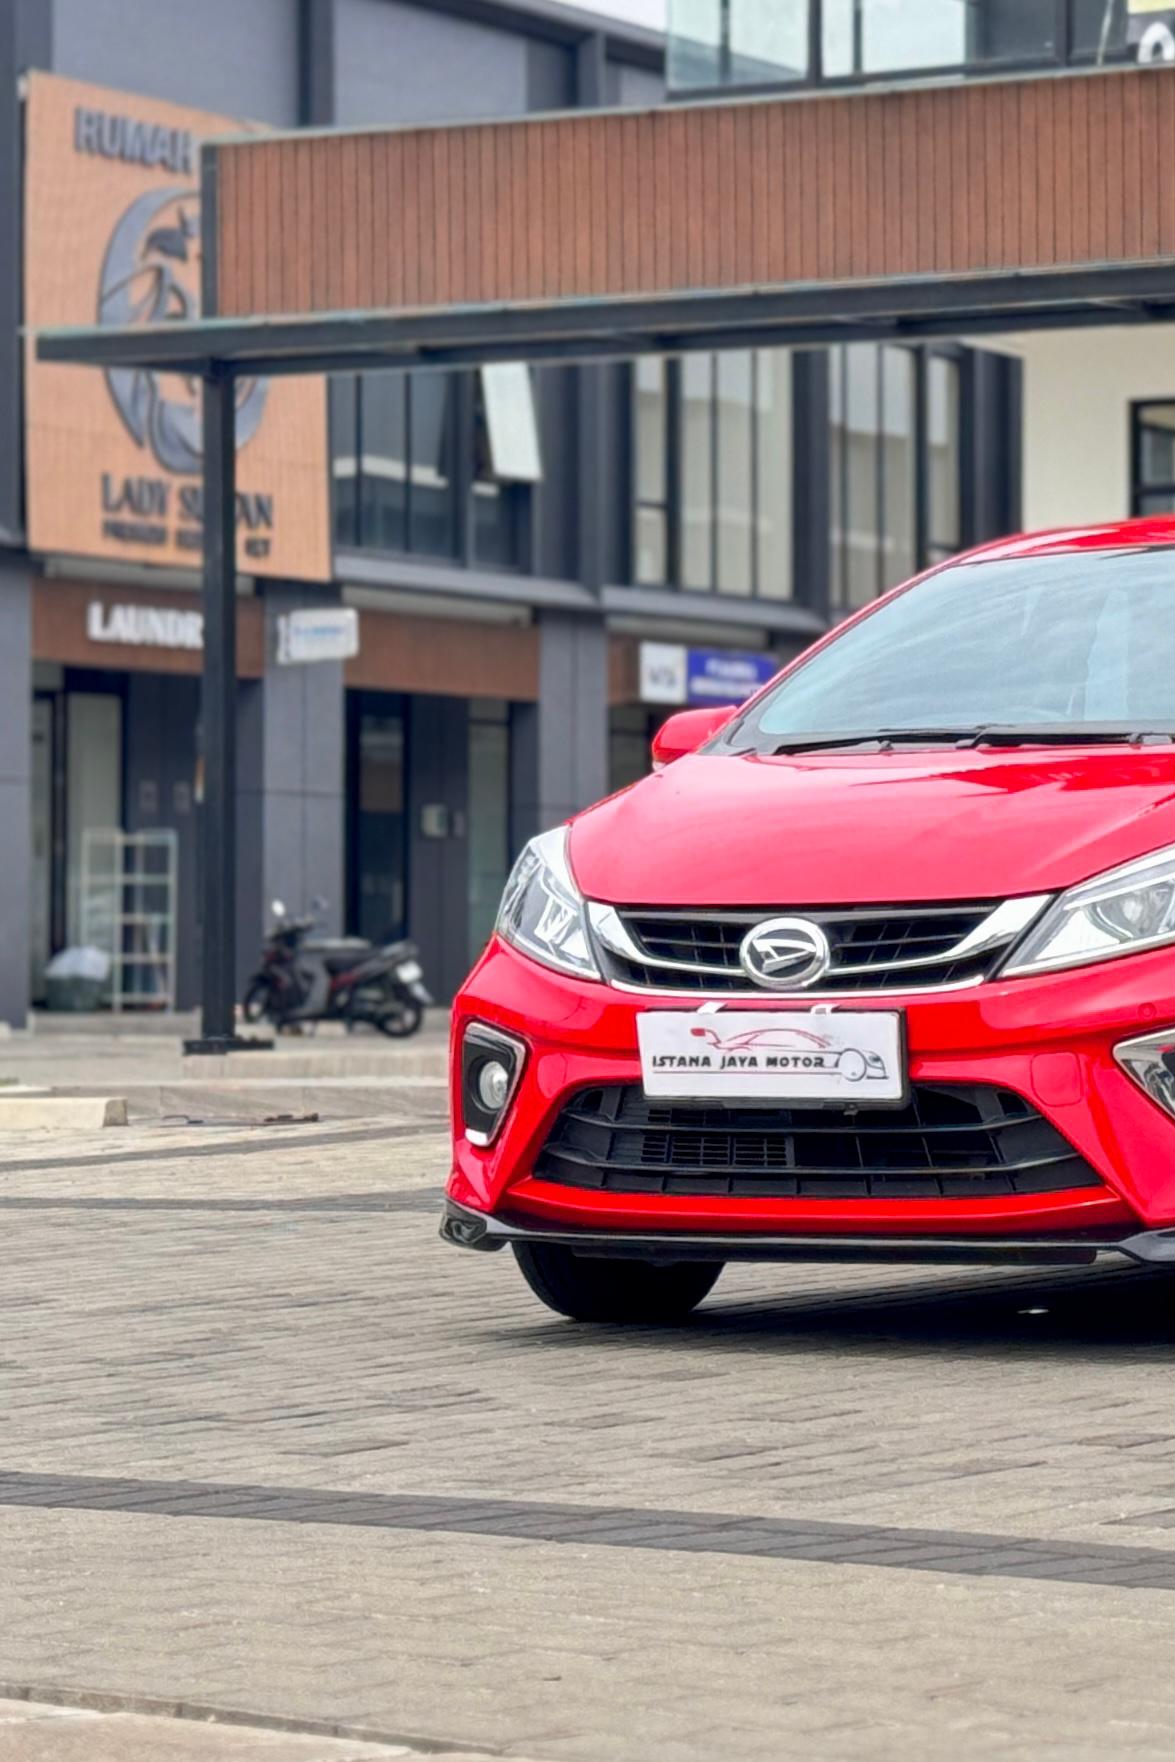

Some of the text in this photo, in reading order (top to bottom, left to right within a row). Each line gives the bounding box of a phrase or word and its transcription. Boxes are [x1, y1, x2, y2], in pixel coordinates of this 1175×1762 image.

[74, 106, 193, 176] RUMAH
[88, 601, 204, 650] LAUNDR
[651, 1054, 826, 1070] ISTANA JAYA MOTOR
